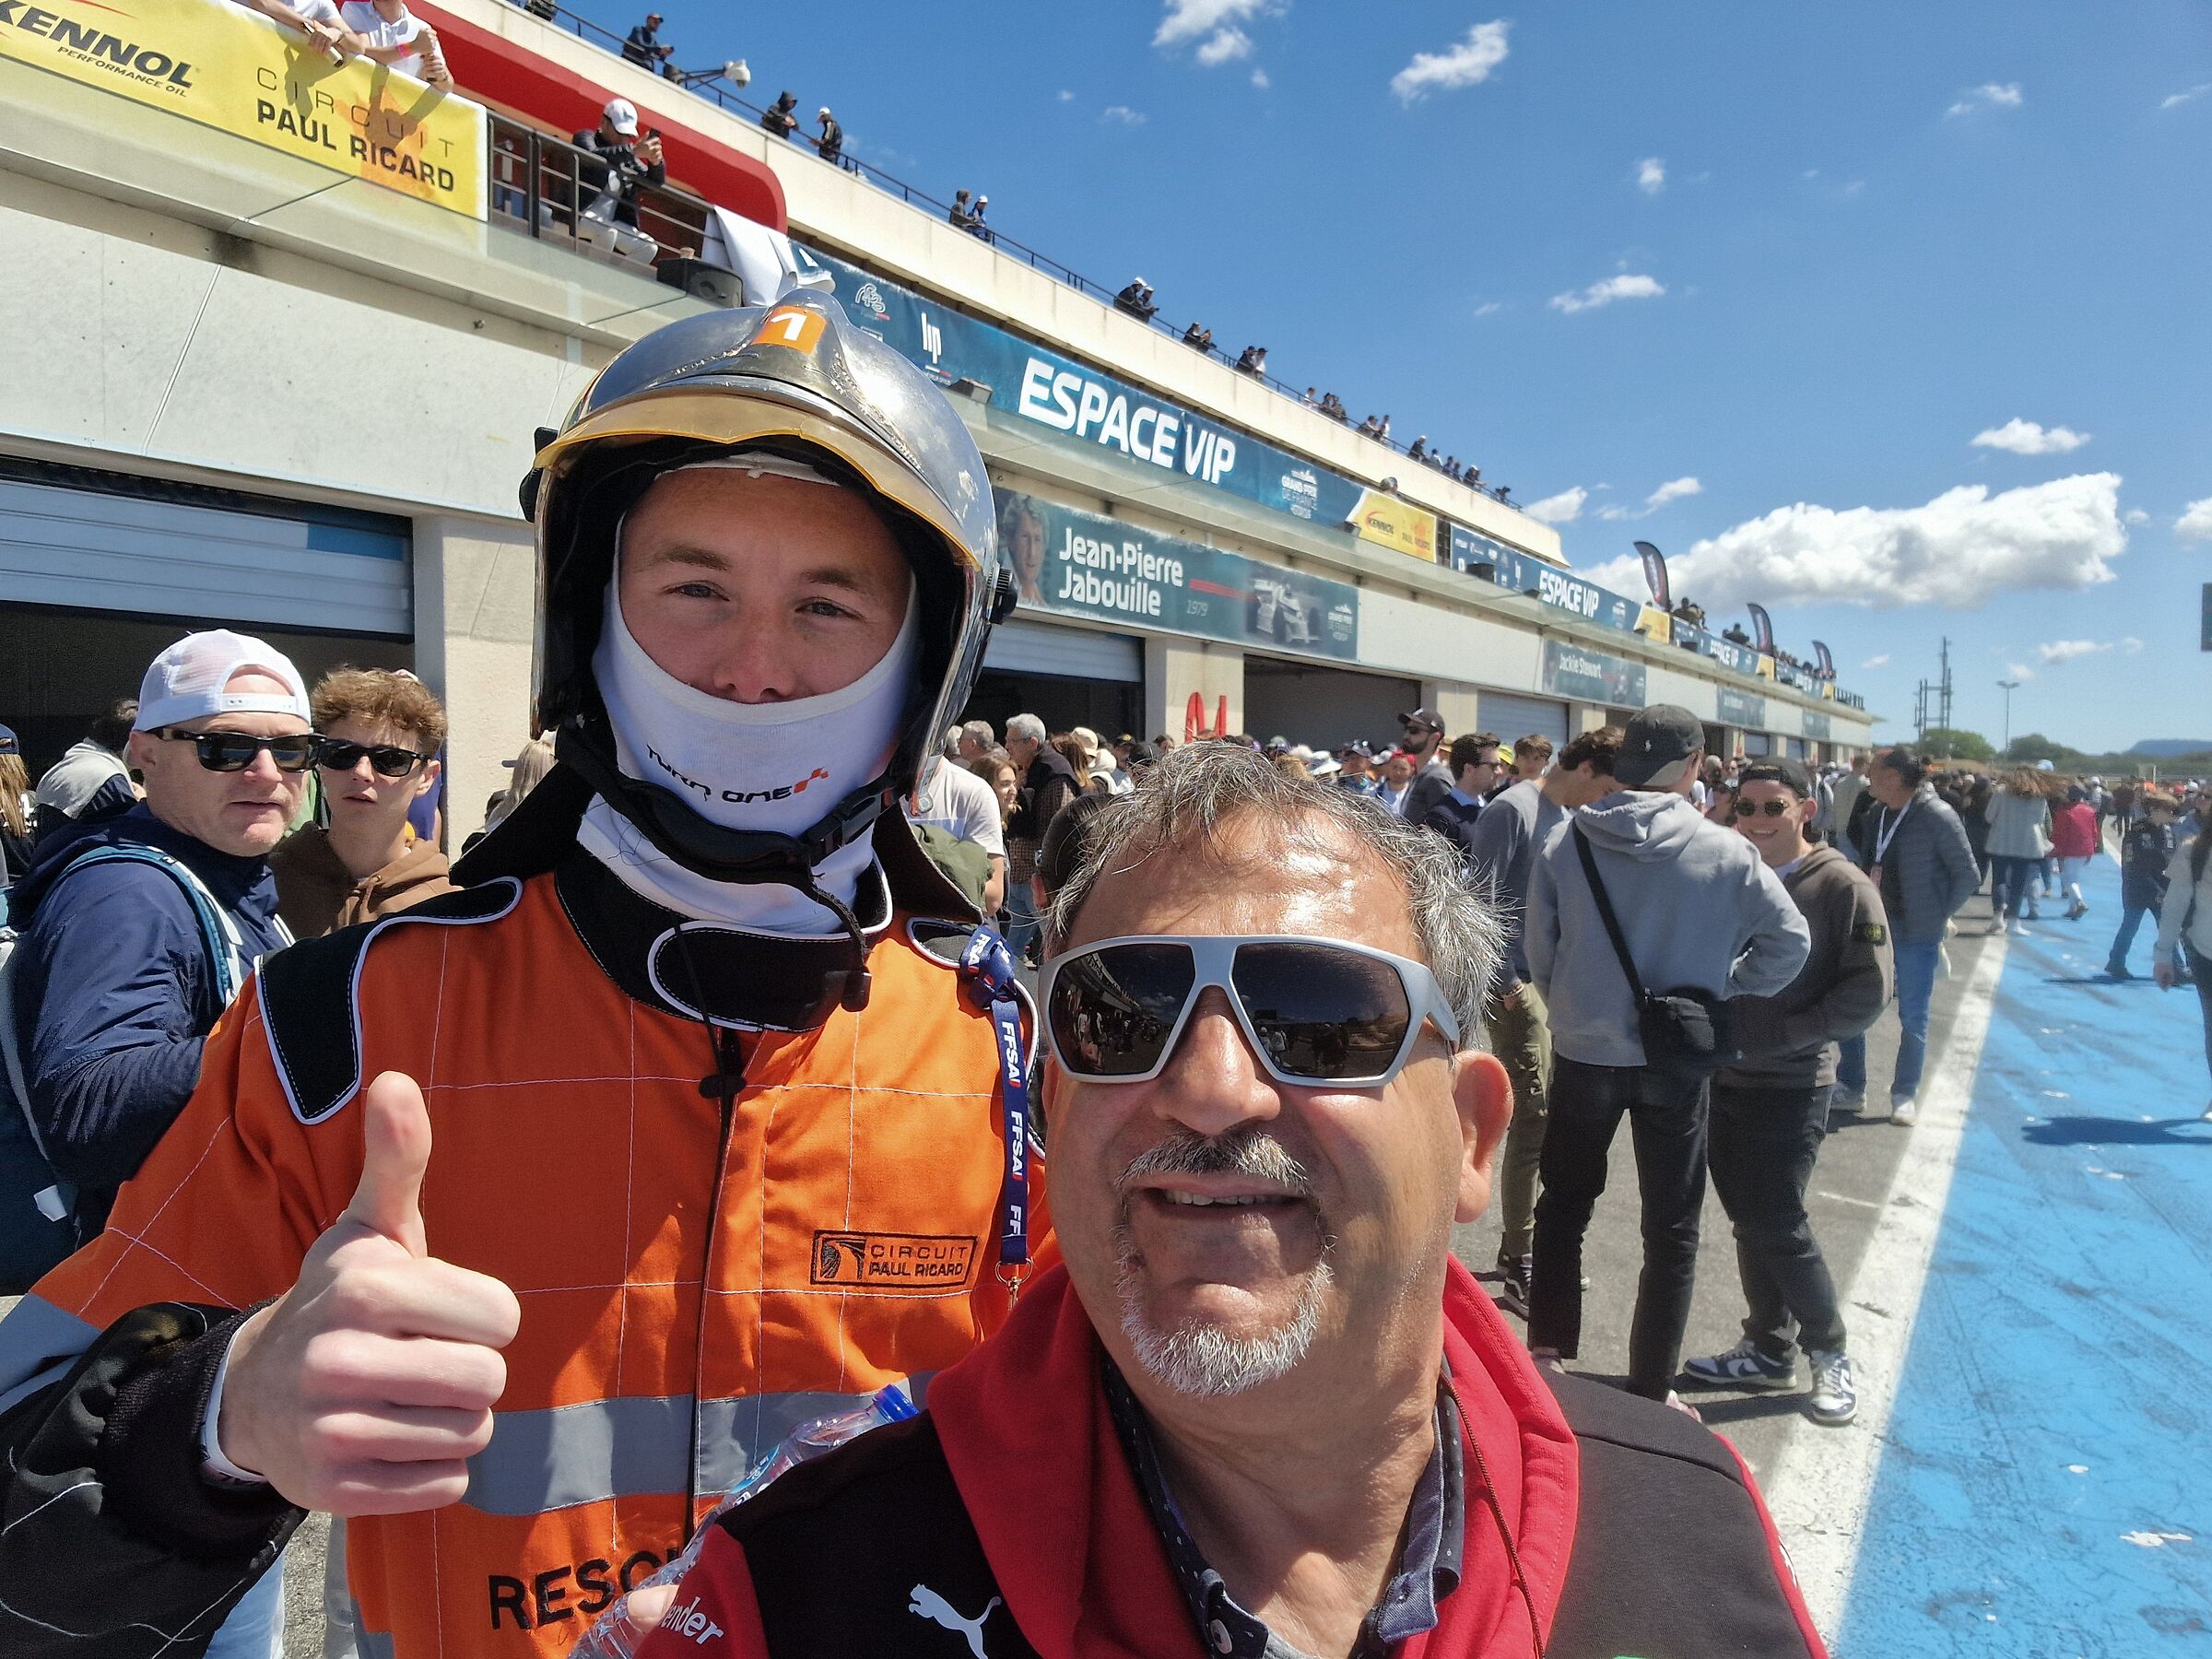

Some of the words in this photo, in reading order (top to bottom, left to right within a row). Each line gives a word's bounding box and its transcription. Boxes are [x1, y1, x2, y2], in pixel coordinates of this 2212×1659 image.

[0, 0, 193, 88] KENNOL
[57, 46, 164, 88] PERFORMANCE
[165, 84, 187, 98] OIL
[257, 66, 454, 158] CIRCUIT
[257, 98, 337, 151] PAUL
[349, 134, 454, 192] RICARD
[771, 312, 807, 341] 1
[1018, 358, 1180, 468] ESPACE
[1184, 423, 1236, 485] VIP
[1059, 526, 1183, 588] Jean-Pierre
[1058, 565, 1161, 617] Jabouille
[1185, 600, 1208, 617] 1979
[1539, 570, 1583, 613] ESPACE
[1583, 583, 1600, 618] VIP
[869, 1261, 911, 1277] PAUL
[914, 1262, 963, 1277] RICARD
[870, 1244, 968, 1260] CIRCUIT
[658, 1596, 724, 1645] ender
